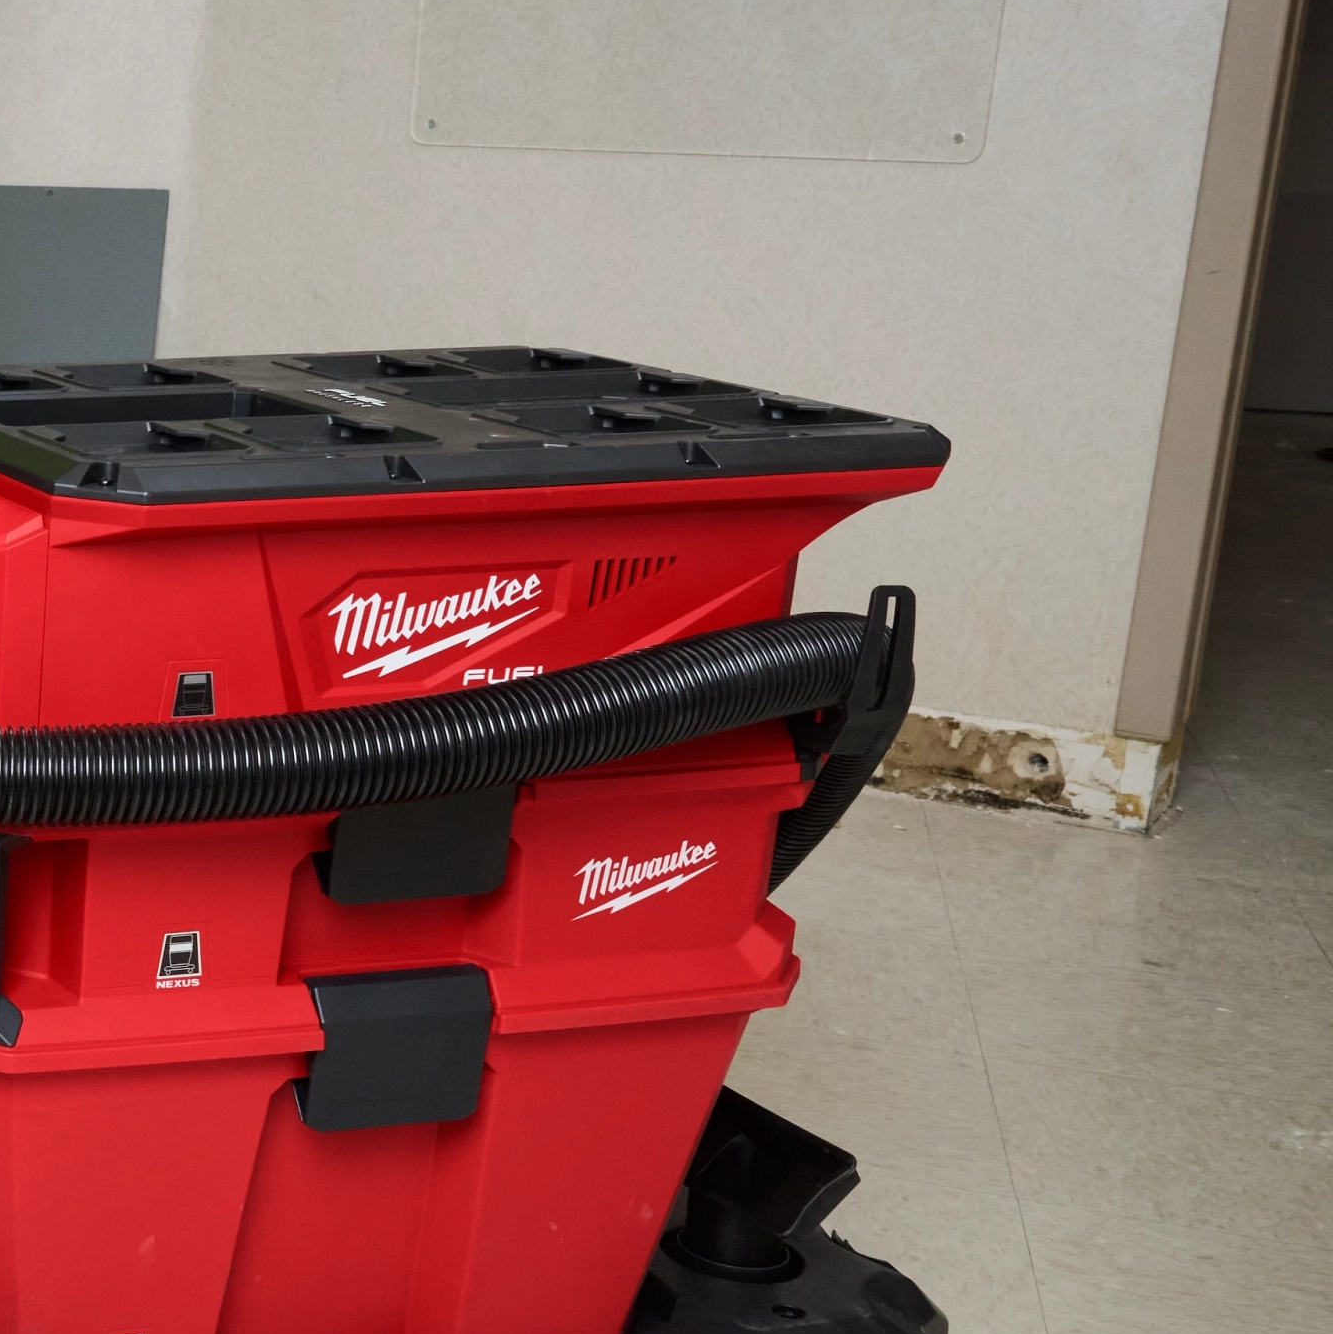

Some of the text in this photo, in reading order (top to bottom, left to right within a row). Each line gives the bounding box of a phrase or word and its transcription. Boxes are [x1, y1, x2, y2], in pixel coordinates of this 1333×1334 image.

[328, 573, 542, 656] Milwaukee
[573, 840, 717, 905] Milwaukee
[156, 978, 200, 989] NEXUS
